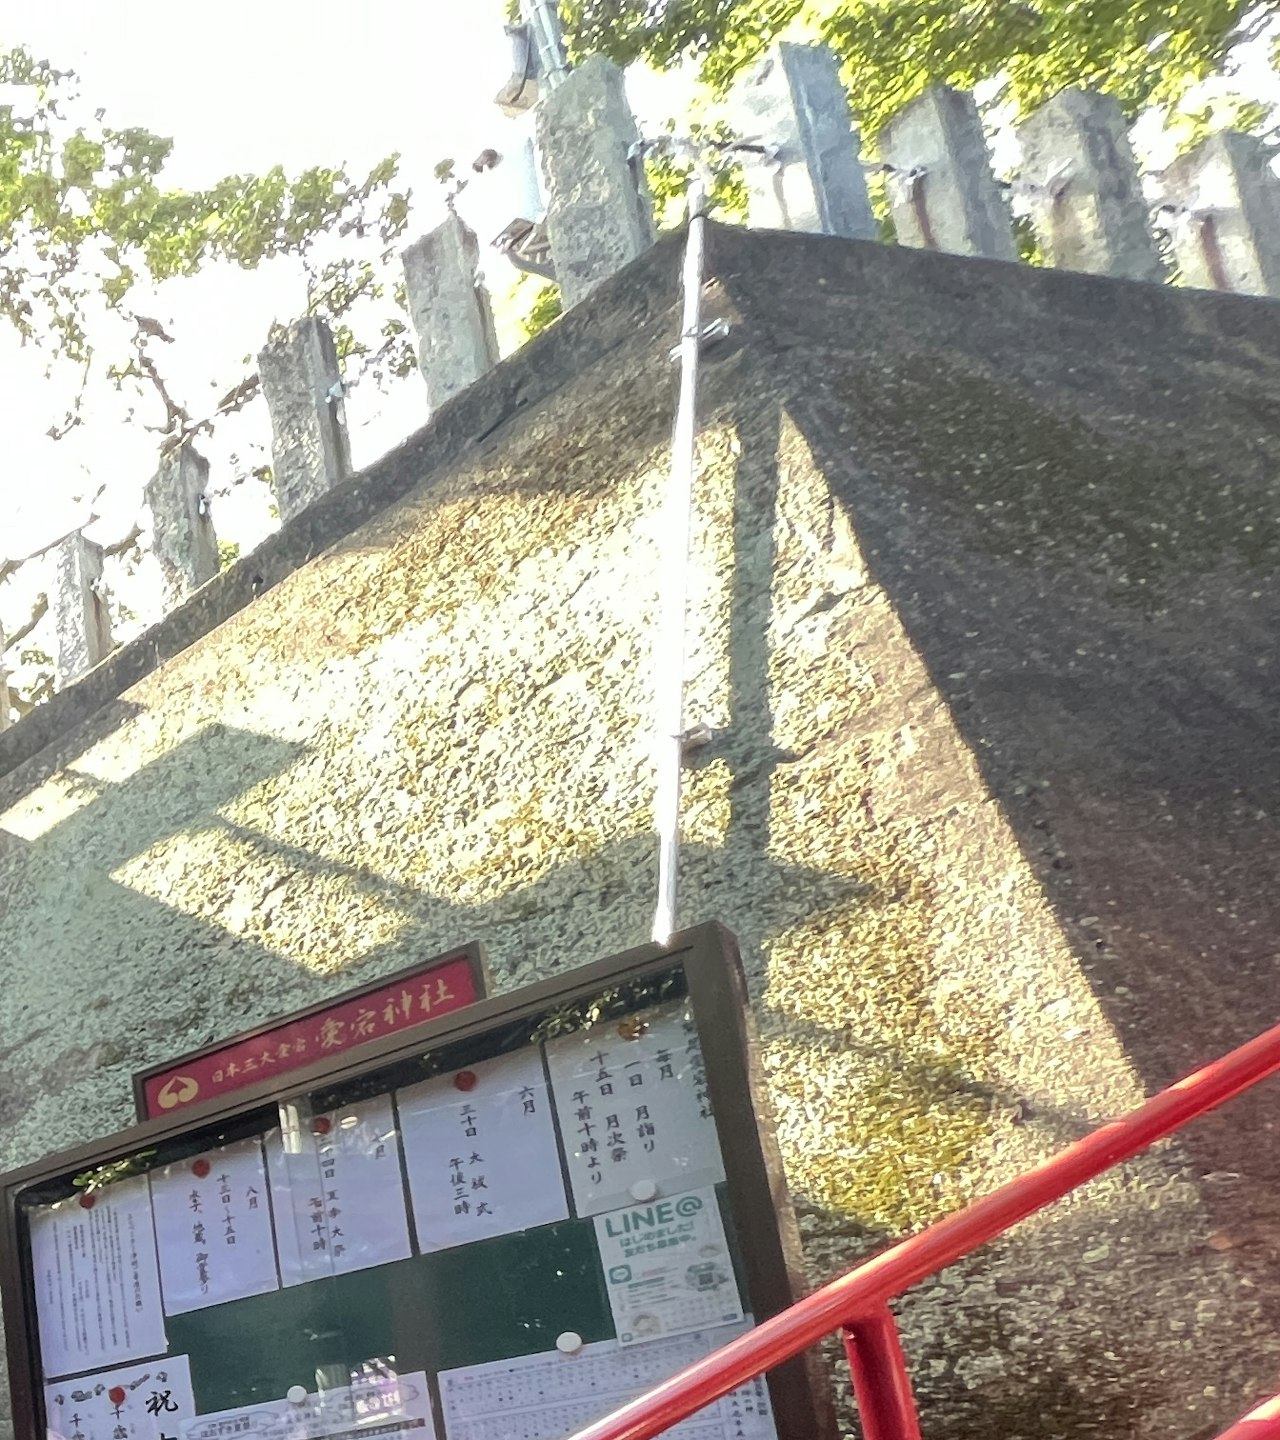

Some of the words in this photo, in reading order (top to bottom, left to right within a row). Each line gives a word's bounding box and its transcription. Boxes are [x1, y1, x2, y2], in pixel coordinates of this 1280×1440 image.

[315, 979, 455, 1049] 愛宕神社
[624, 1061, 643, 1087] 一日
[655, 1049, 674, 1081] 毎月
[459, 1104, 477, 1137] 三十日
[518, 1086, 536, 1117] 六月
[590, 1051, 614, 1096] 十五日
[605, 1114, 628, 1163] 月次祭
[571, 1090, 602, 1185] 午前十時より
[246, 1185, 259, 1210] 八月
[449, 1157, 471, 1215] 午後三時
[605, 1195, 703, 1238] LINE@
